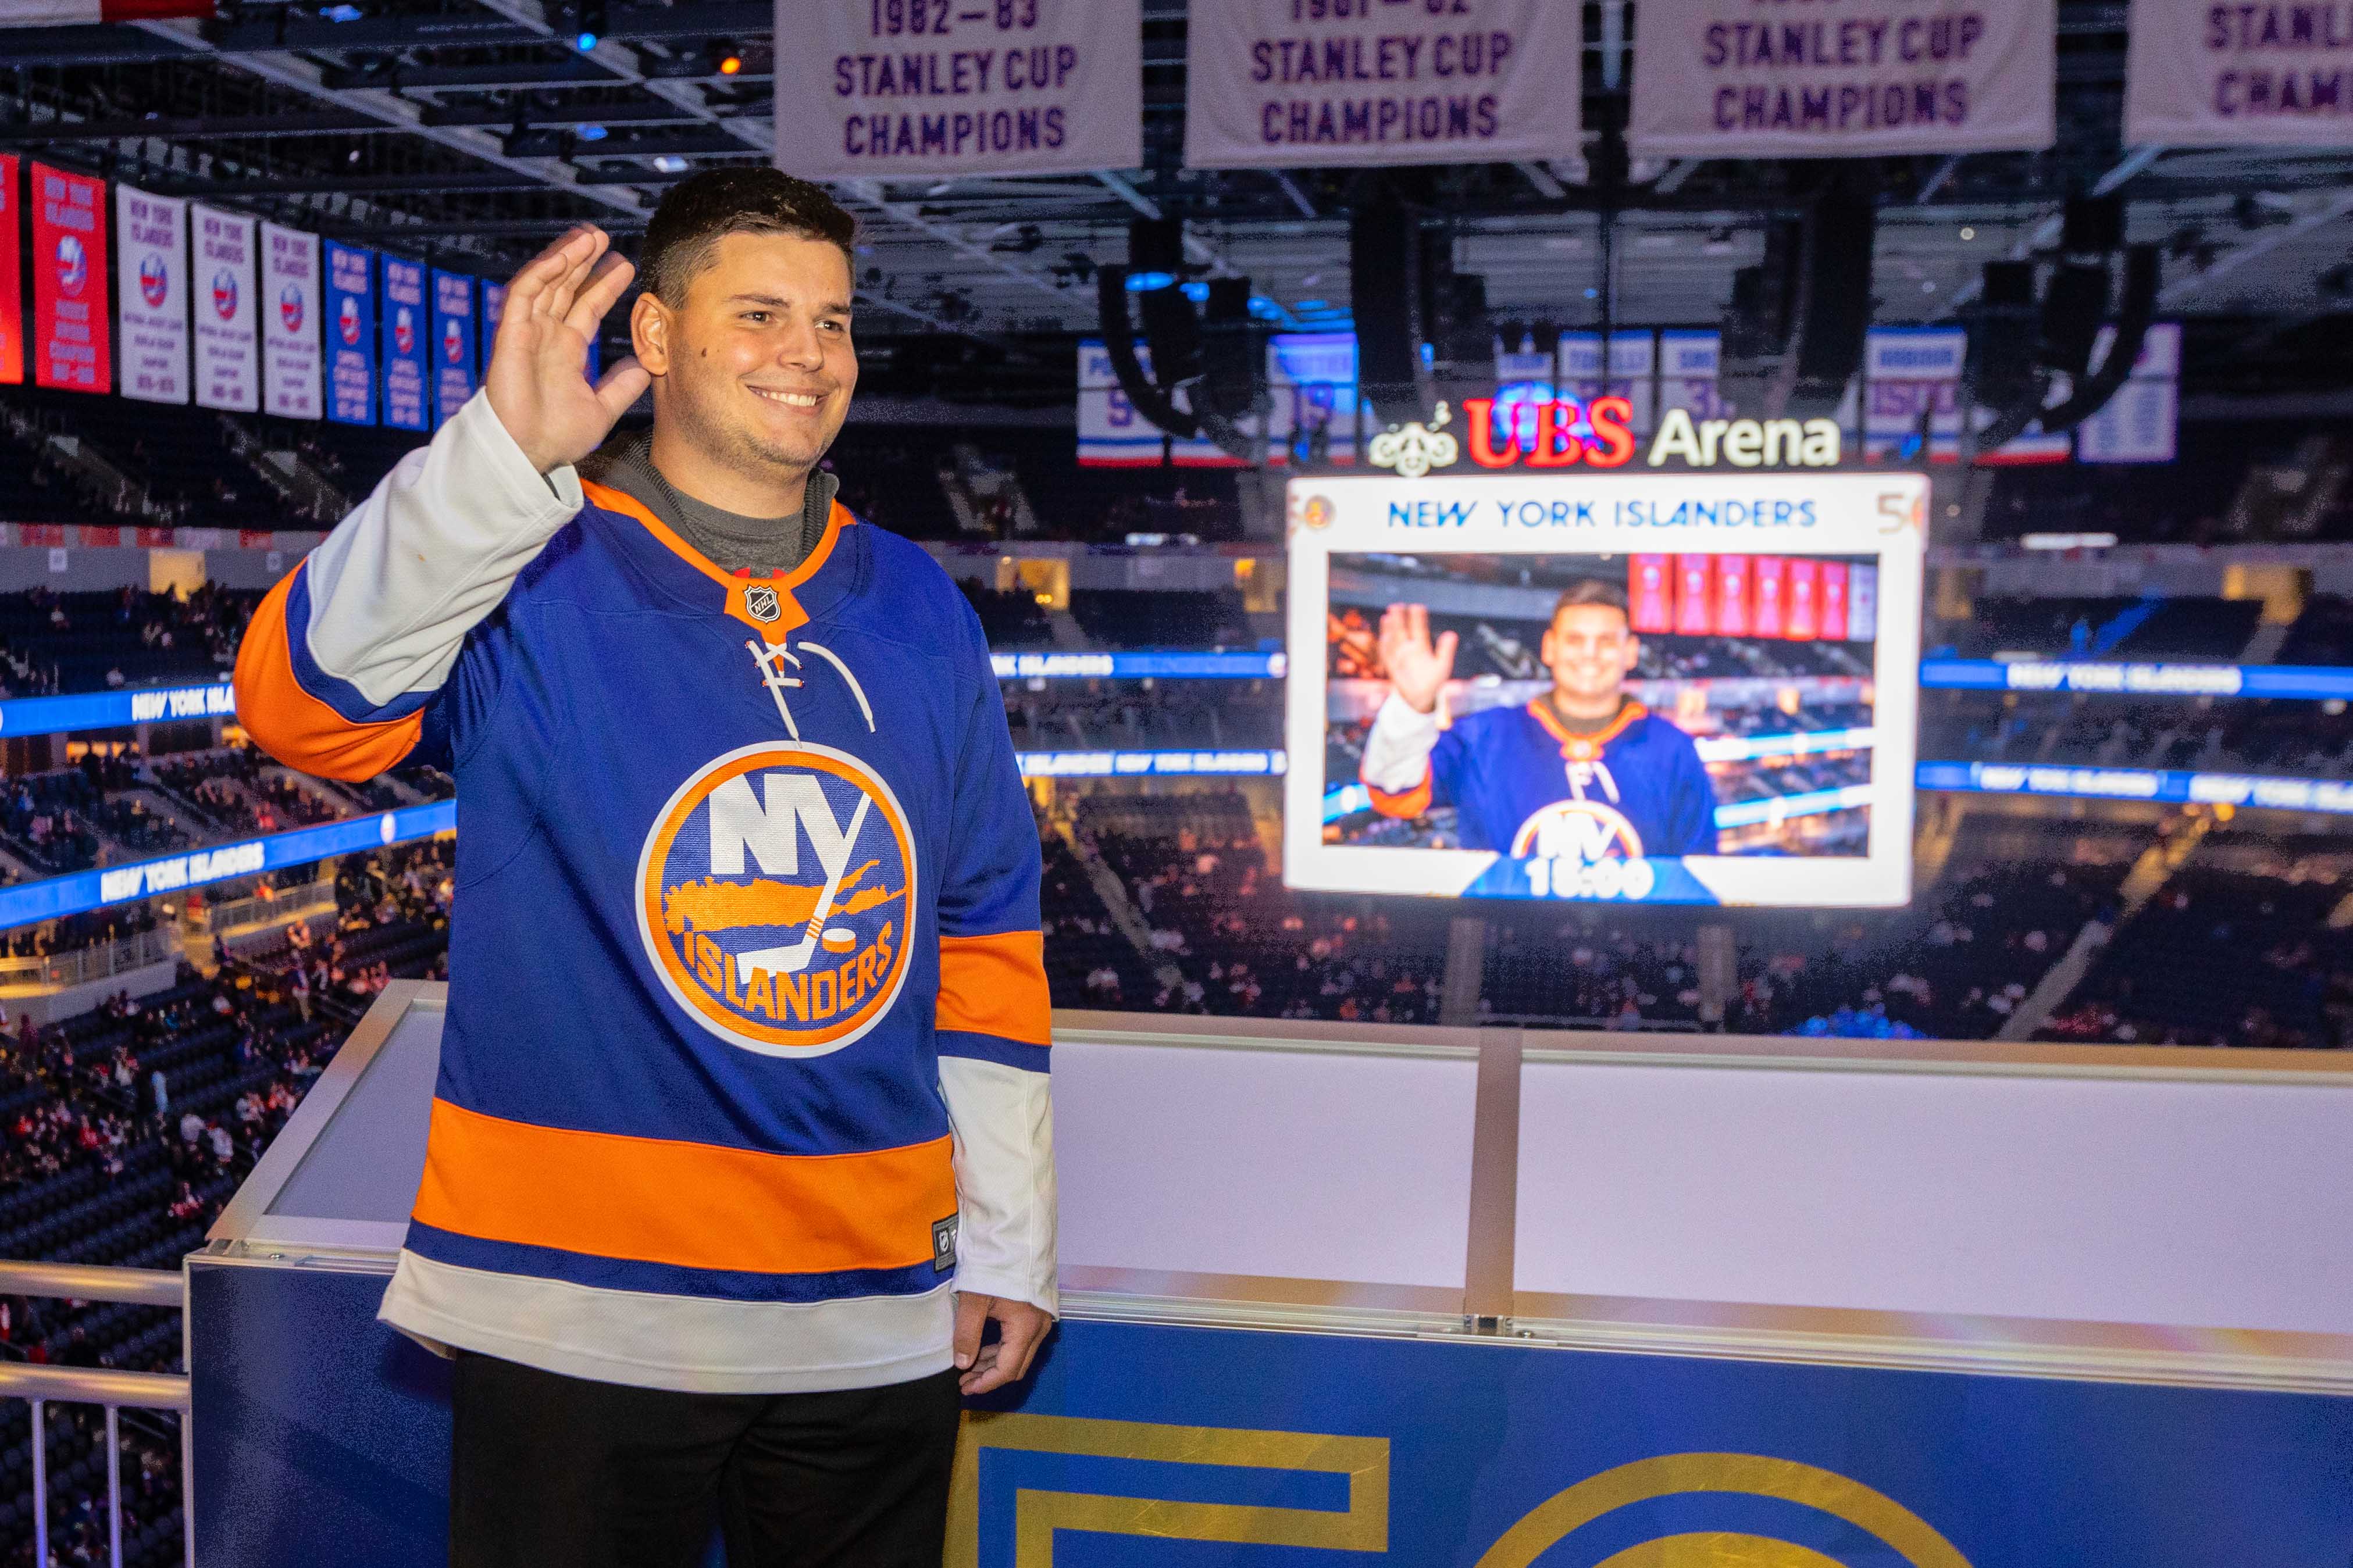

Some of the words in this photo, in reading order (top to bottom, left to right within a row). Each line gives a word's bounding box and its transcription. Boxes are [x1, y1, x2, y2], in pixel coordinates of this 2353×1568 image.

[1252, 36, 1423, 82] STANLEY
[1434, 32, 1511, 77] CUP
[1705, 20, 1889, 68] STANLEY
[1899, 13, 1982, 60] CUP
[835, 50, 992, 97] STANLEY
[1004, 45, 1076, 90] CUP
[1261, 94, 1499, 144] CHAMPIONS
[1713, 80, 1967, 130] CHAMPIONS
[844, 107, 1067, 156] CHAMPIONS
[1463, 397, 1635, 468] UBS
[1647, 408, 1841, 467] Arena
[1388, 500, 1478, 528] NEW
[1495, 500, 1596, 527] YORK
[1614, 499, 1817, 527] ISLANDERS
[754, 595, 773, 614] NHL
[709, 773, 872, 877] NY
[683, 920, 892, 1022] ISLANDERS
